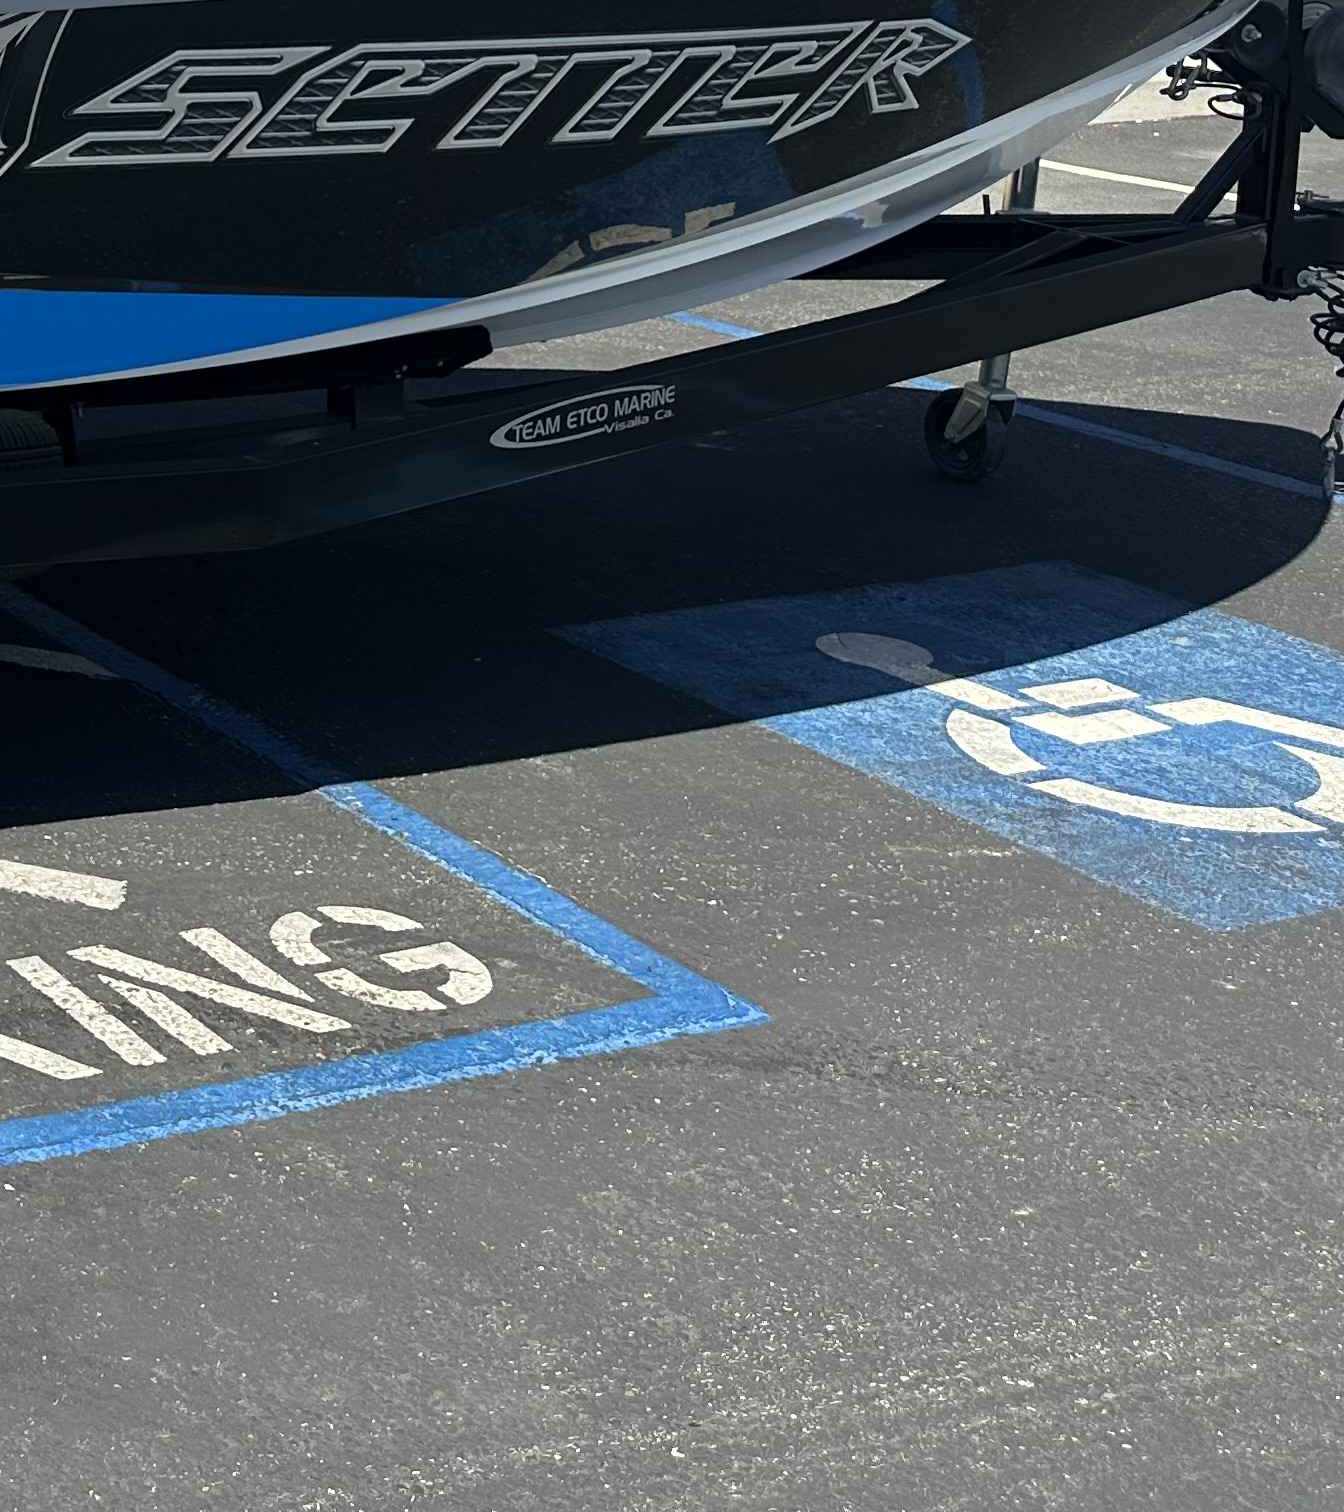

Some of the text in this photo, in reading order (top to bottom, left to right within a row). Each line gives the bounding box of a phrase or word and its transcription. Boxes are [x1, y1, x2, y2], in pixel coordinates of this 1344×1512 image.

[511, 385, 676, 444] TEAM ETCO MARINE
